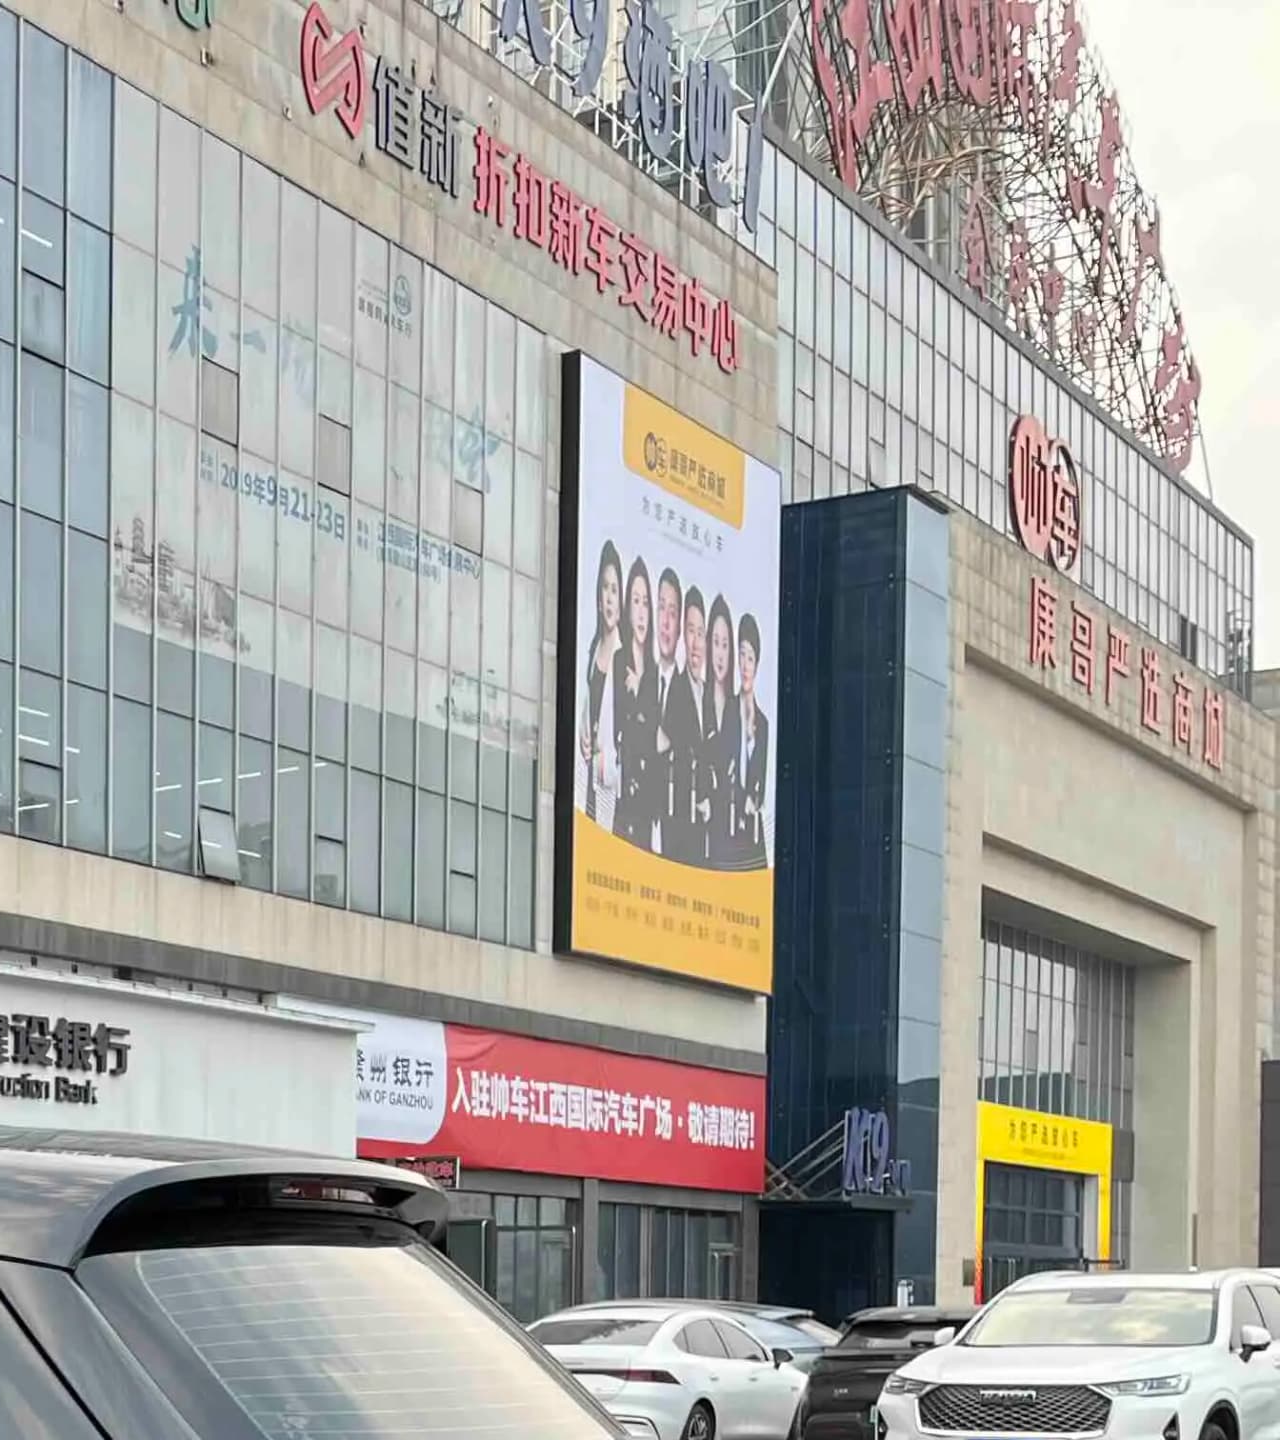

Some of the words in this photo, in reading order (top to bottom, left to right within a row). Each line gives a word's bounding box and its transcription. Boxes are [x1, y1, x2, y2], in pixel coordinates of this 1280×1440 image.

[473, 126, 739, 375] 折扣新车交易中心
[54, 1076, 99, 1105] Bank
[374, 1089, 388, 1105] OF
[389, 1092, 434, 1111] GANZHOU
